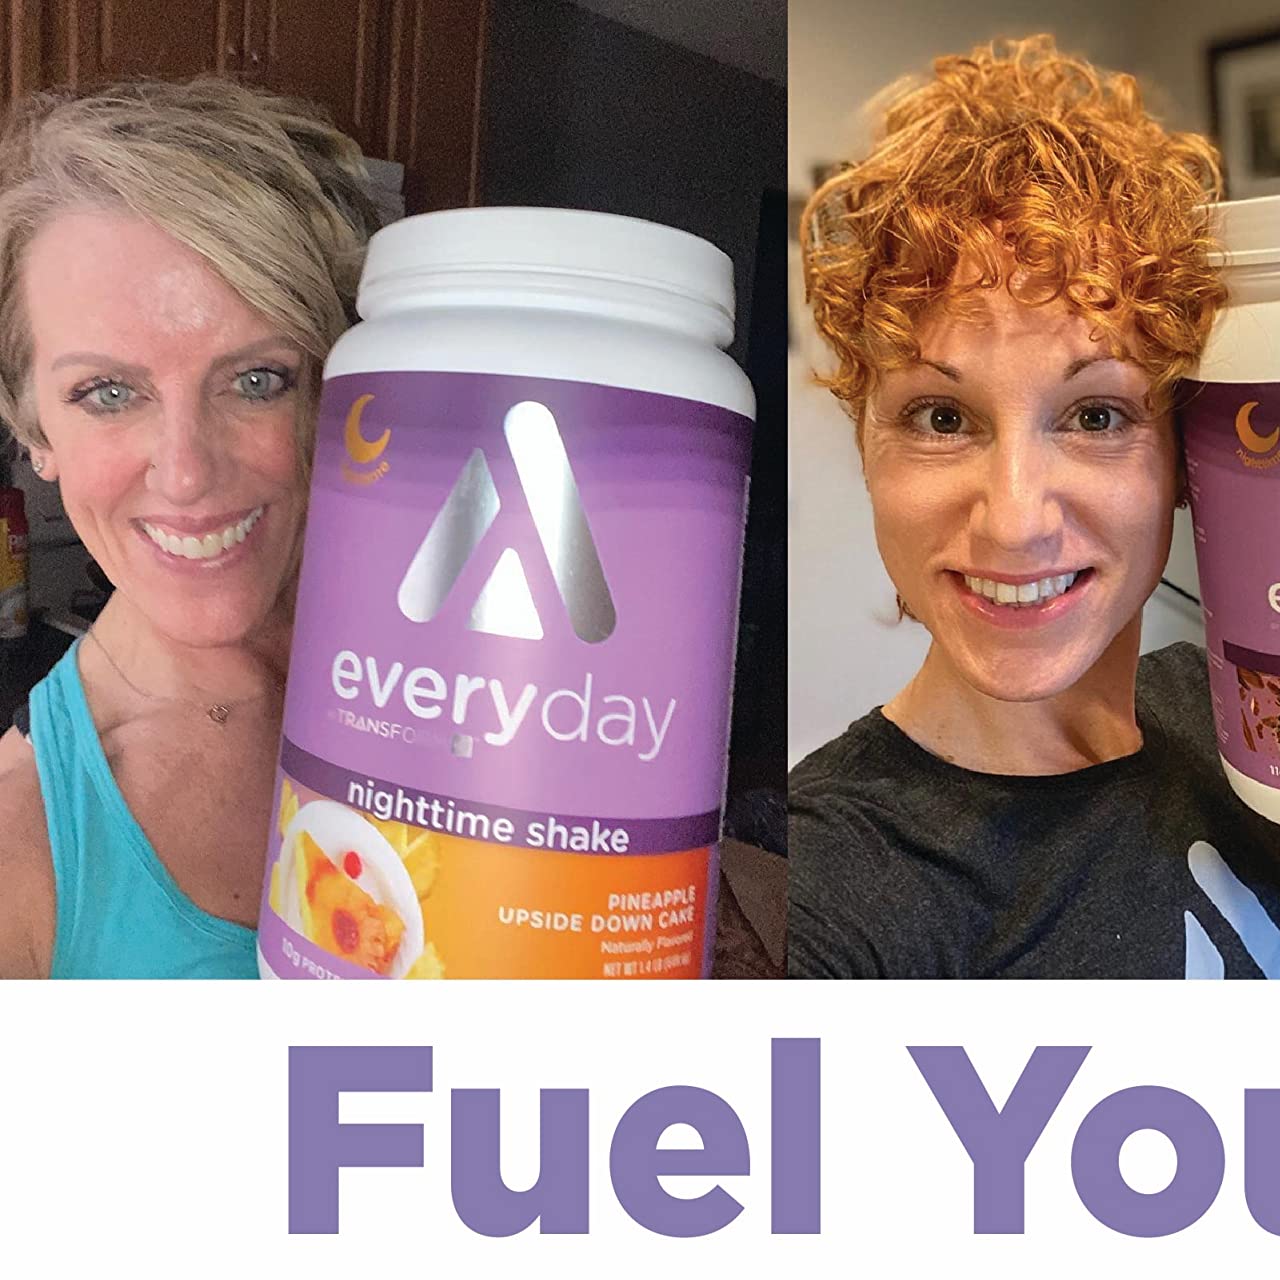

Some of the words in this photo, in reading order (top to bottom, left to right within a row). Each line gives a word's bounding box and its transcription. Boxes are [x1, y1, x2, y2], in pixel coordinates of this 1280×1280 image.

[331, 650, 677, 761] everyday
[337, 708, 450, 746] TRANSFO
[348, 779, 515, 844] nighttime
[527, 814, 630, 854] shake
[608, 885, 696, 911] PINEAPPLE
[498, 906, 583, 932] UPSIDE
[591, 913, 653, 933] DOWN
[658, 905, 695, 929] CAKE
